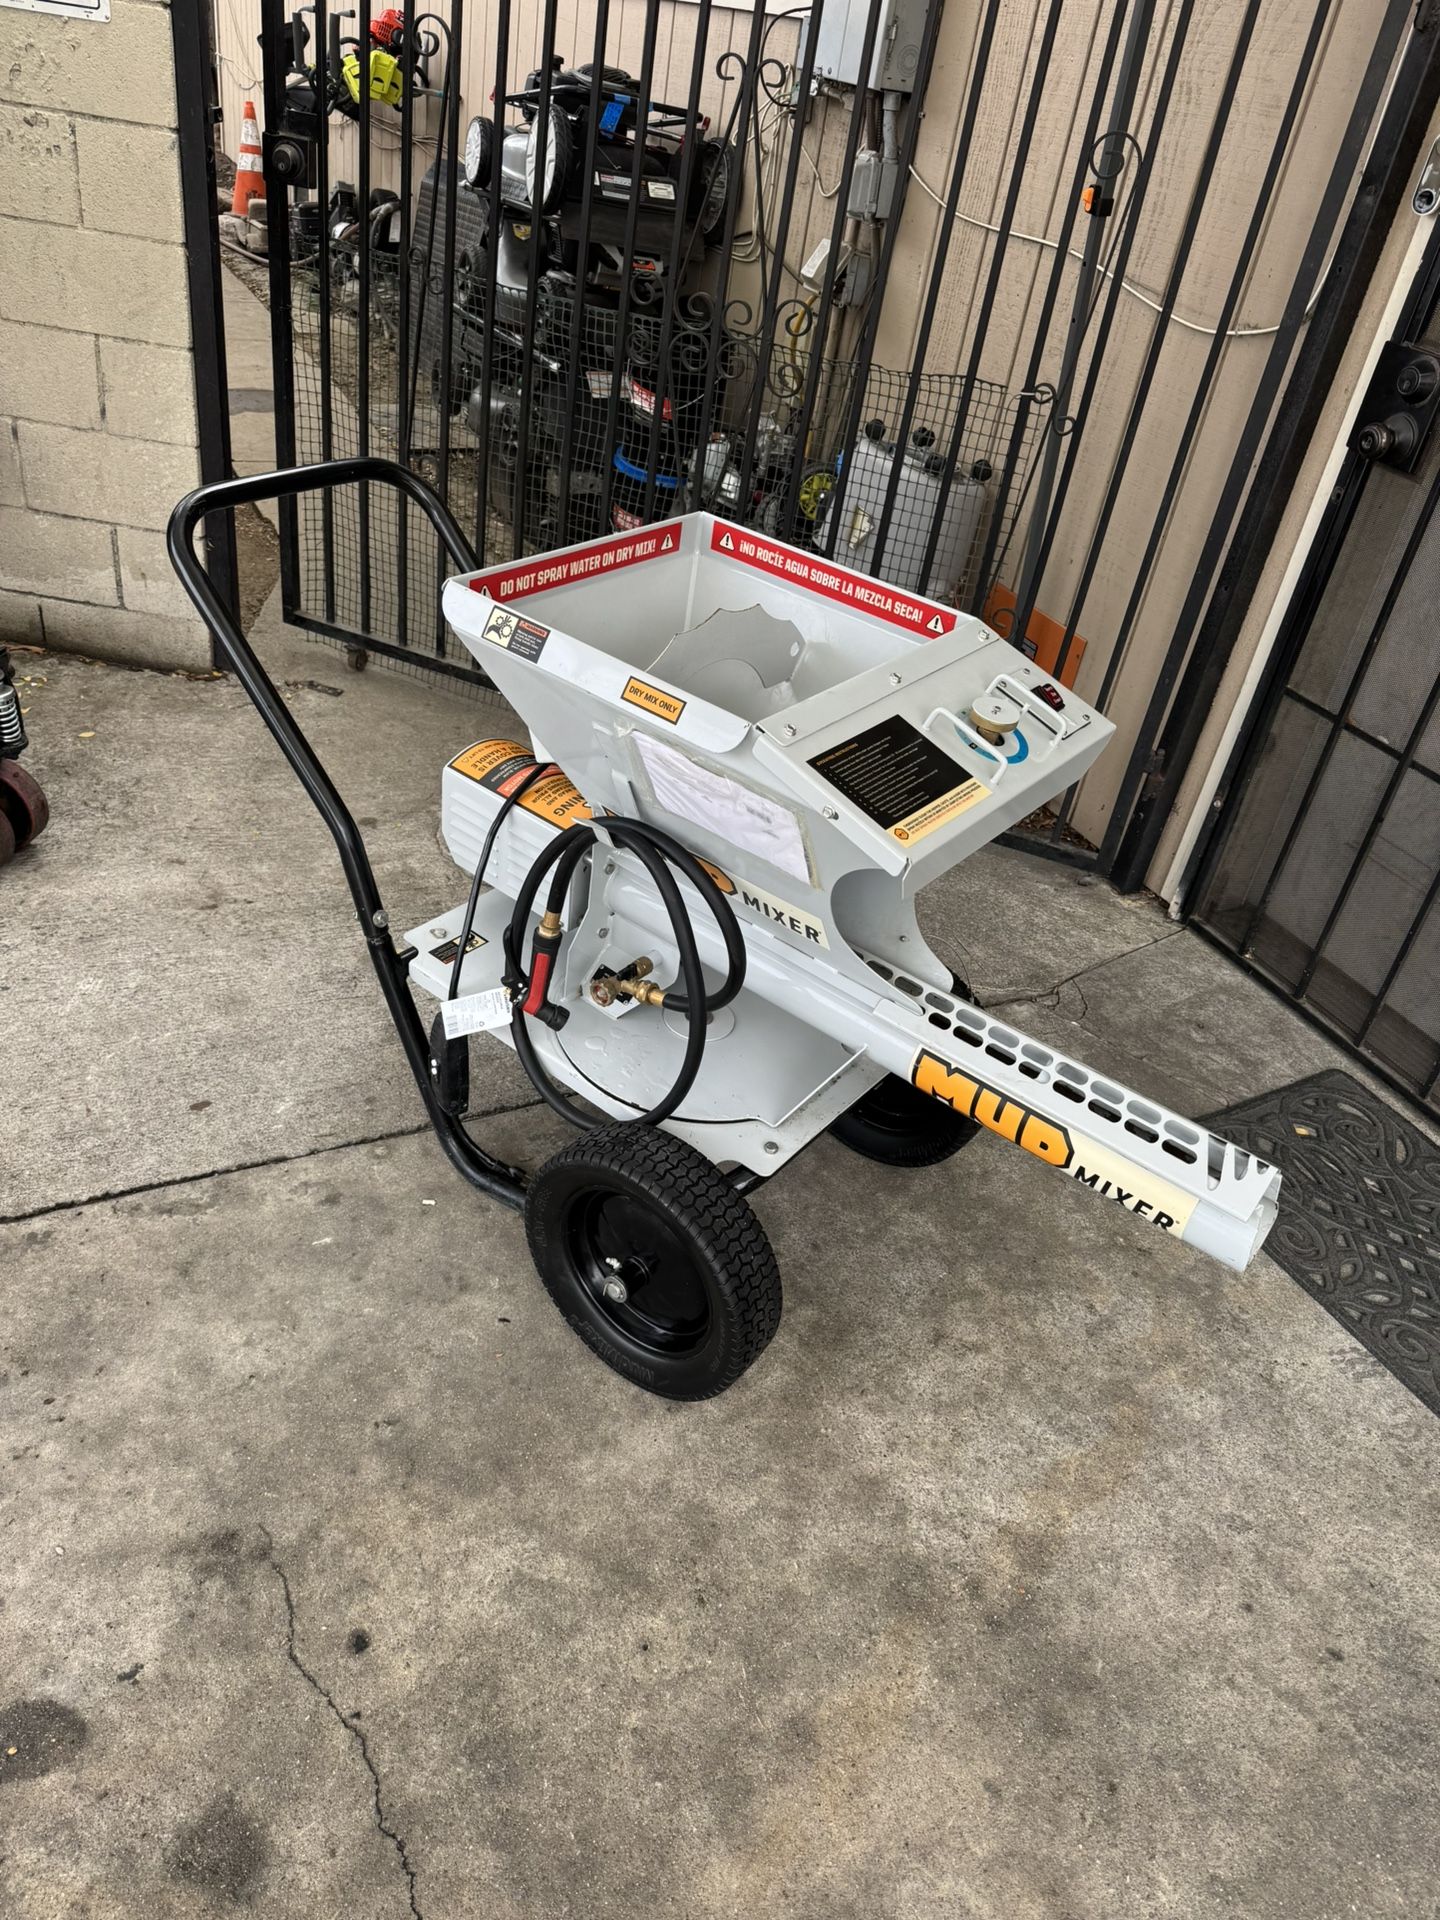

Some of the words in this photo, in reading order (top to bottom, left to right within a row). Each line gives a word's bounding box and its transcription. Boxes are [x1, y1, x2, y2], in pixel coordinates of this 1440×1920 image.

[500, 580, 514, 597] DO
[516, 573, 536, 592] NOT
[537, 564, 569, 585] SPRAY
[570, 555, 600, 577] WATER
[602, 550, 615, 567] ON
[616, 543, 633, 563] DRY
[634, 538, 657, 557] MIX!
[756, 546, 784, 568] ROCÍE
[784, 558, 809, 579] AGUA
[810, 569, 841, 591] SOBRE
[841, 583, 854, 597] LA
[854, 588, 892, 612] MEZCLA
[893, 602, 924, 623] SECA!
[628, 685, 645, 698] DRY
[643, 693, 659, 705] MIX
[658, 700, 679, 713] ONLY
[470, 748, 501, 769] HANDLE
[477, 764, 487, 772] IS
[486, 750, 512, 767] COVER
[553, 794, 585, 816] NING
[742, 890, 820, 944] MIXER
[911, 1047, 1075, 1169] MUD
[1073, 1166, 1175, 1231] MIXER
